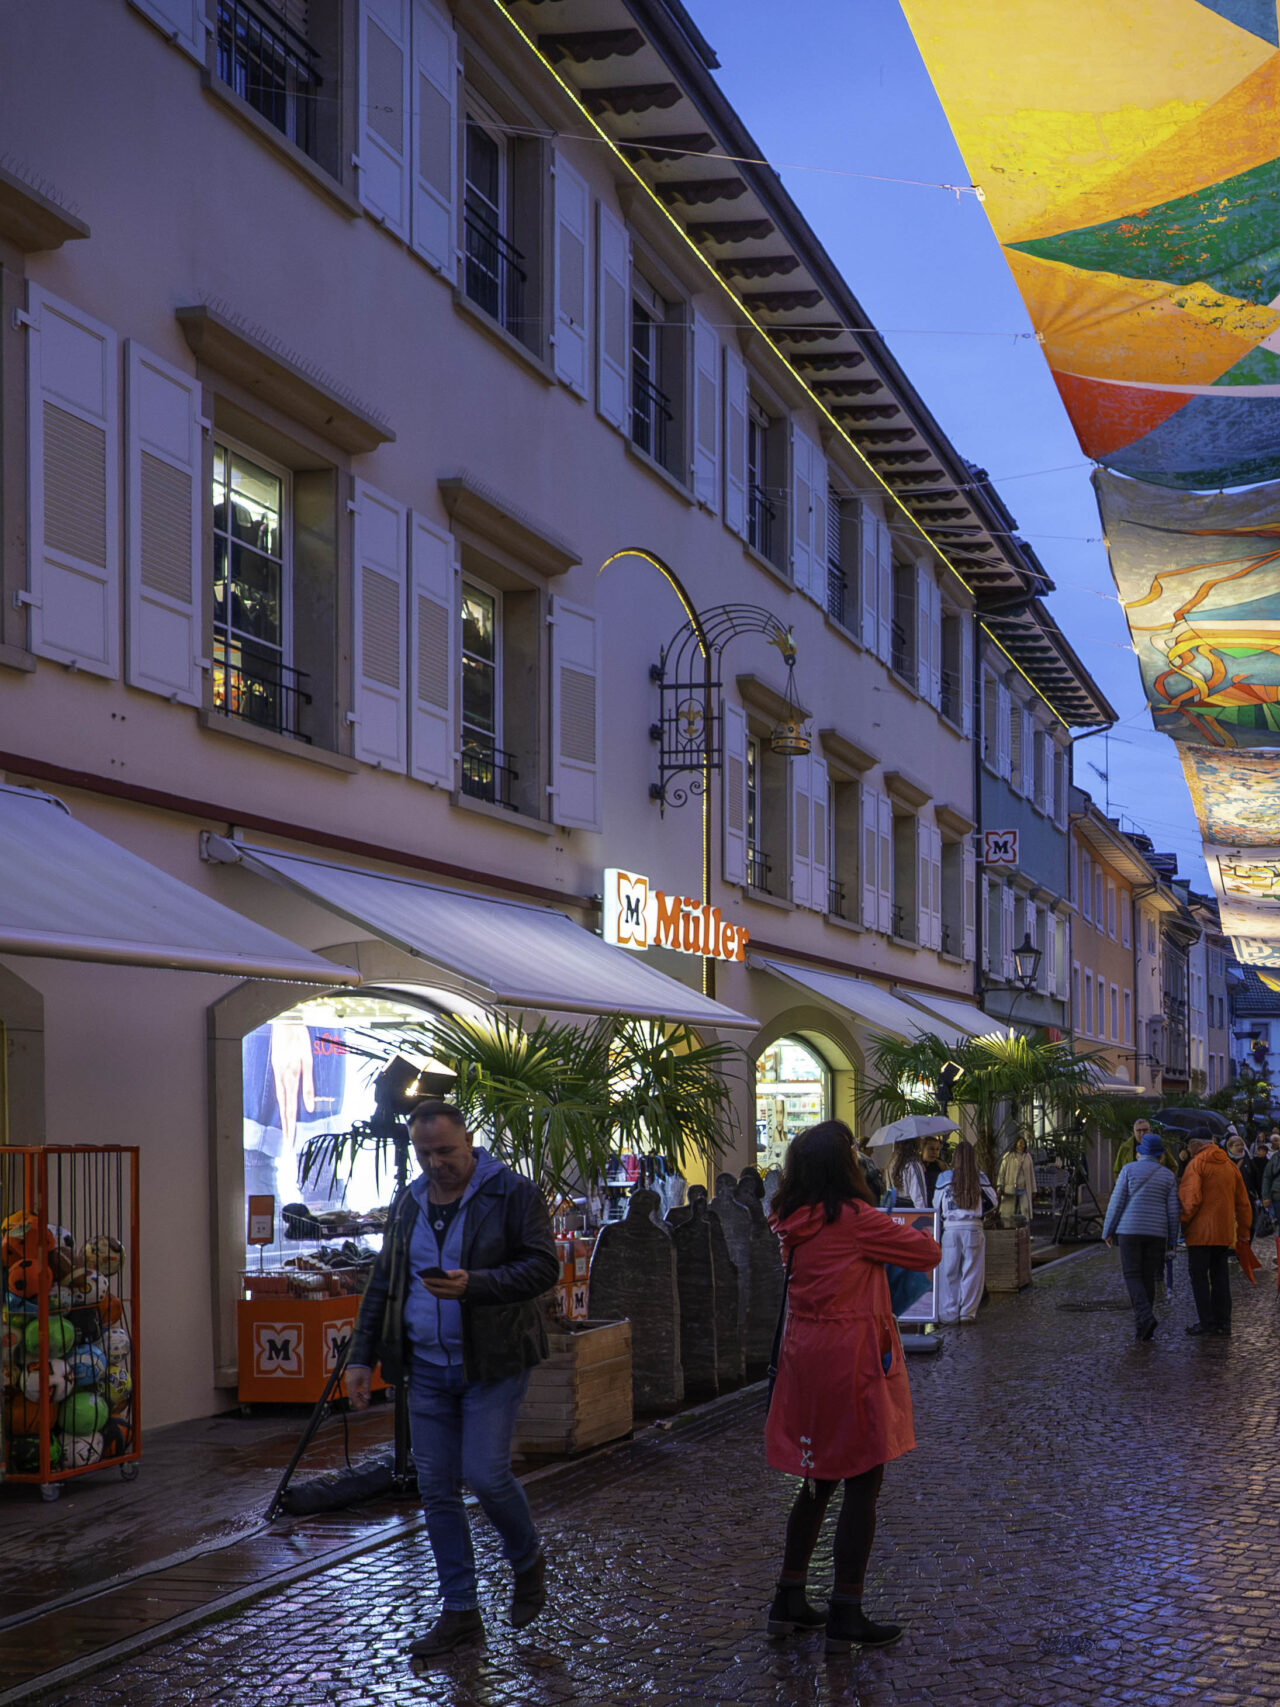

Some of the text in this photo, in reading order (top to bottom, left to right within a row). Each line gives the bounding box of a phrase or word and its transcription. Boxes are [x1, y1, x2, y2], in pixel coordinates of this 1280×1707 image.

[993, 840, 1009, 854] M
[625, 890, 750, 962] M Müller
[267, 1339, 291, 1361] M
